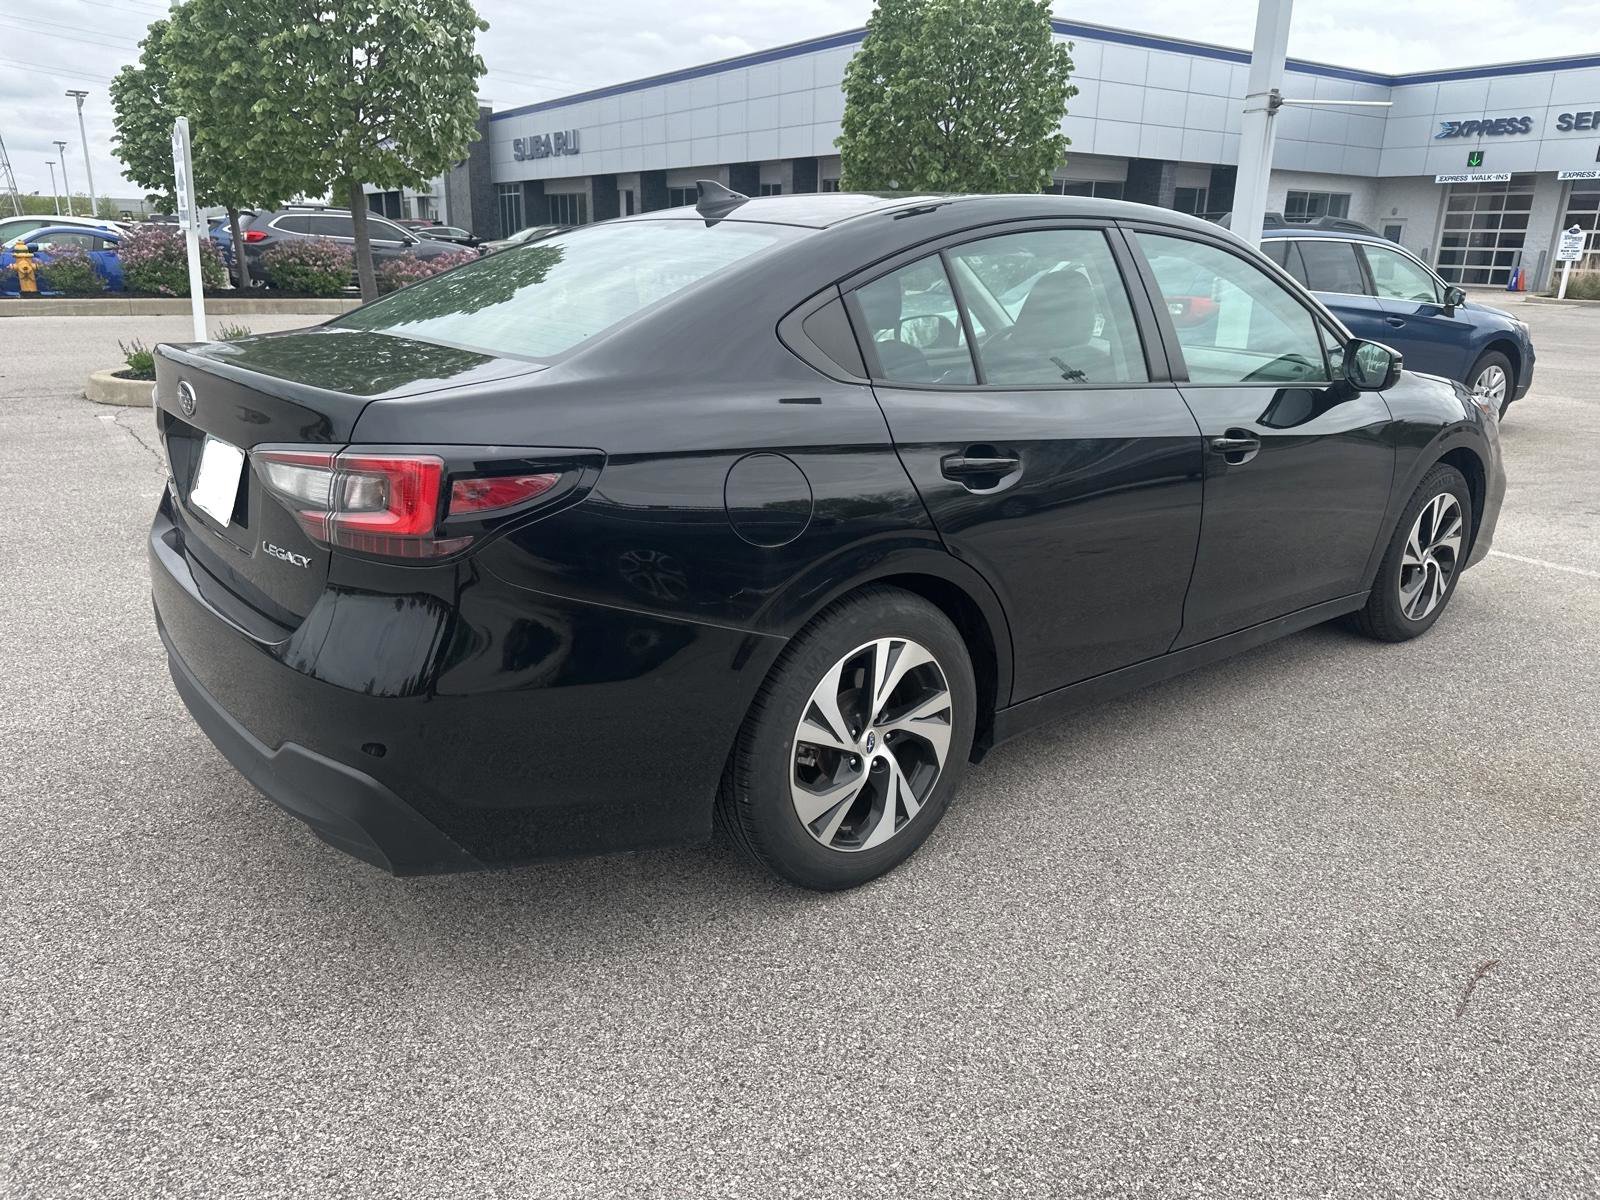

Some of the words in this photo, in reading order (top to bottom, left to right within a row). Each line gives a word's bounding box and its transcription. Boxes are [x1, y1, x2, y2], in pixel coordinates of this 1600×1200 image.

[1435, 115, 1534, 139] EXPRESS
[513, 129, 580, 162] SUBARU
[1471, 173, 1509, 182] WALK-INS
[1560, 171, 1597, 179] EXPRESS
[262, 540, 312, 569] LEGACY
